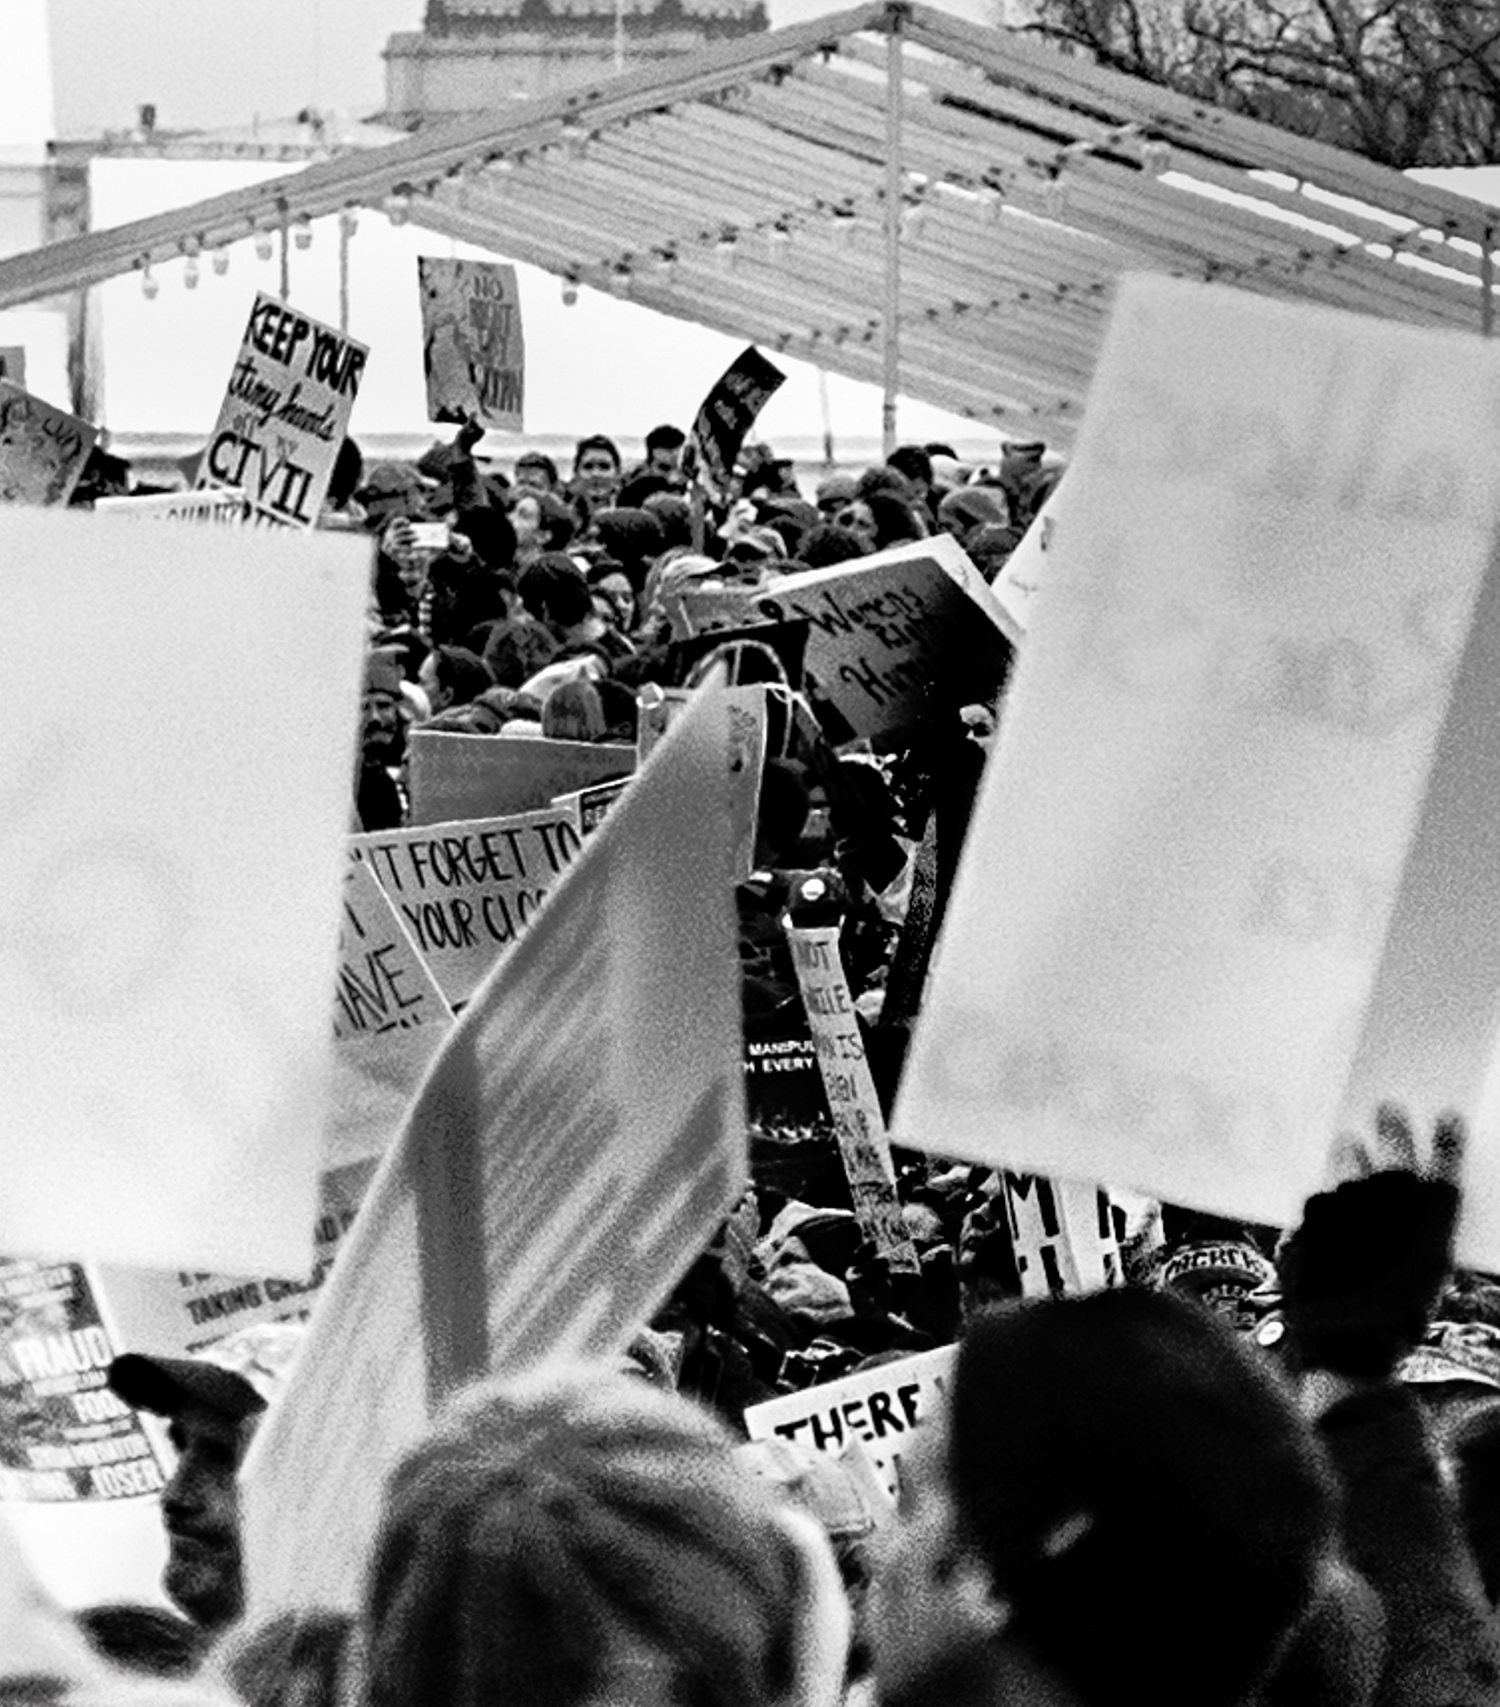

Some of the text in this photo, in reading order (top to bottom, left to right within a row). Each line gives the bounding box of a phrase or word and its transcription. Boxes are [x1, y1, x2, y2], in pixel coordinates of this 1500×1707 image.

[244, 296, 366, 401] KEEP YOUR
[208, 430, 314, 525] CIVIL
[408, 828, 527, 889] FORGET
[402, 897, 478, 952] YOUR
[762, 1058, 814, 1073] EVERY
